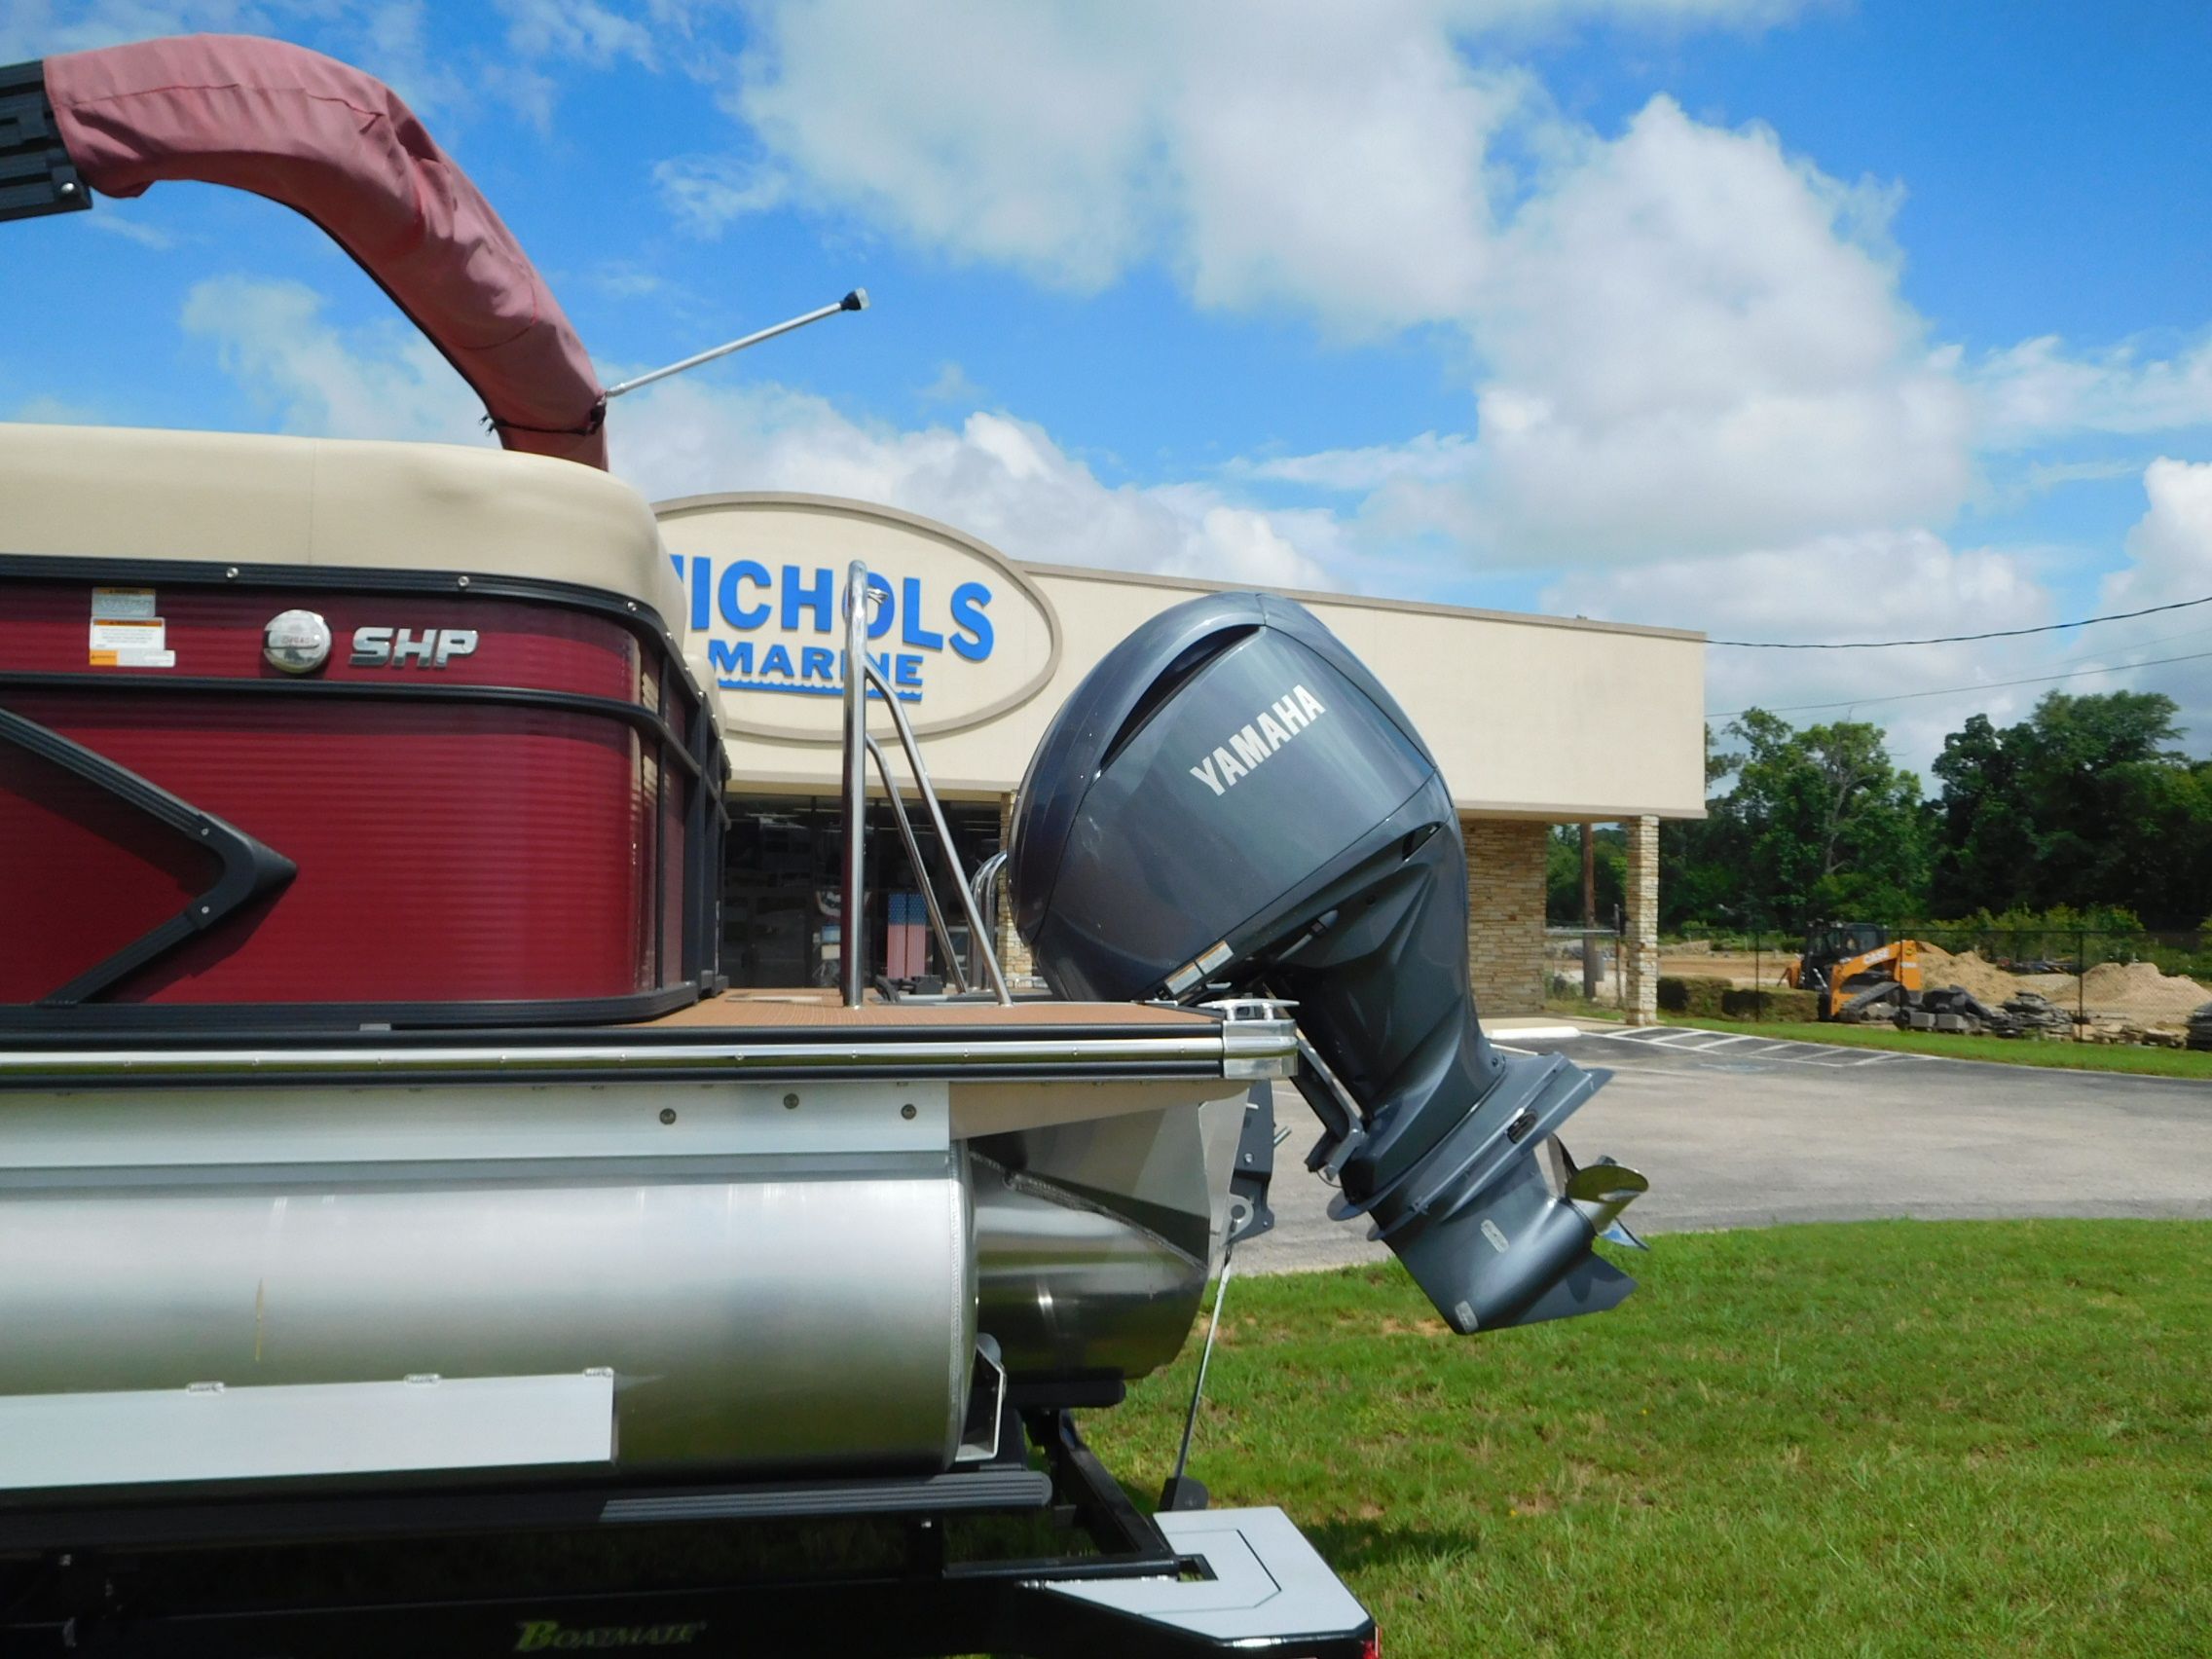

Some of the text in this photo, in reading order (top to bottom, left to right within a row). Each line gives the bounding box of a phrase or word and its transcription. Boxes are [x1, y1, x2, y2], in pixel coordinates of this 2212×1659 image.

[349, 626, 478, 669] SHP
[670, 554, 995, 662] ICHOLS
[1190, 684, 1327, 796] YAMAHA
